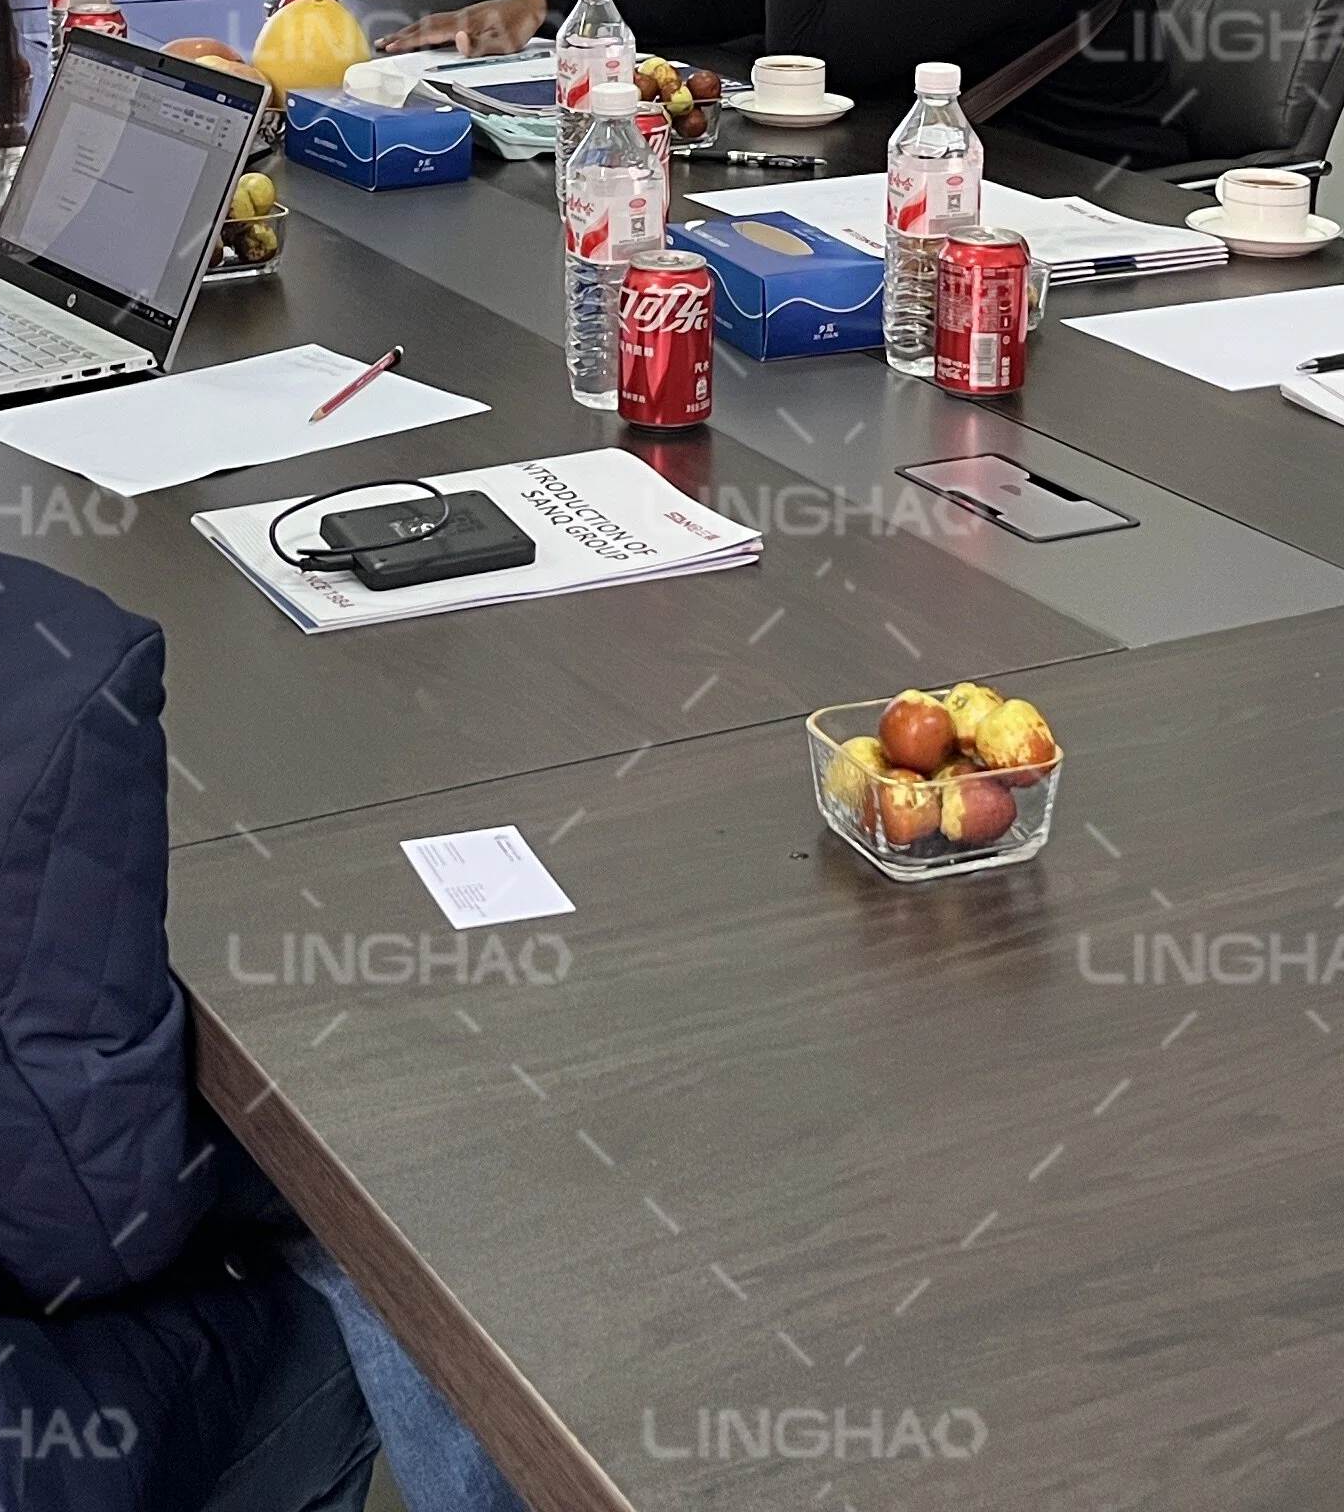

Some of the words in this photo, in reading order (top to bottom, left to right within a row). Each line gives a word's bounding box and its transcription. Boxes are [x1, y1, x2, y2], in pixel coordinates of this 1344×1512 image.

[520, 489, 574, 526] SANQ
[565, 525, 629, 561] GROUP
[624, 538, 658, 556] OF
